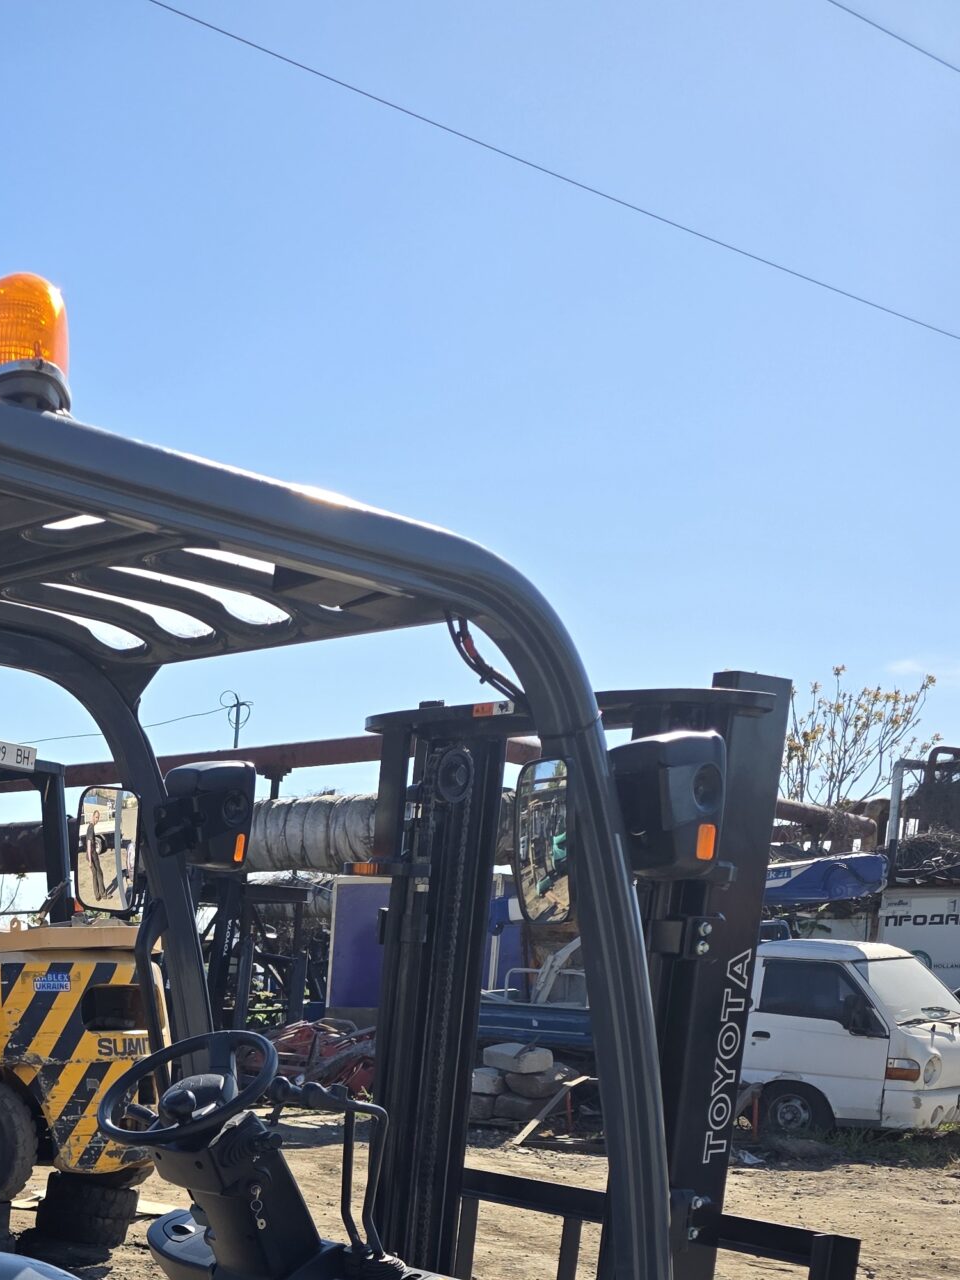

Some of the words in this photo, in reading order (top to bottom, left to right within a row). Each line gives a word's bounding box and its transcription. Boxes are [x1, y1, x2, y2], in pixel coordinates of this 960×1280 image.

[15, 748, 31, 767] BH
[885, 913, 960, 927] ПРОДА
[35, 982, 70, 990] UKRAINE
[702, 948, 753, 1164] TOYOTA
